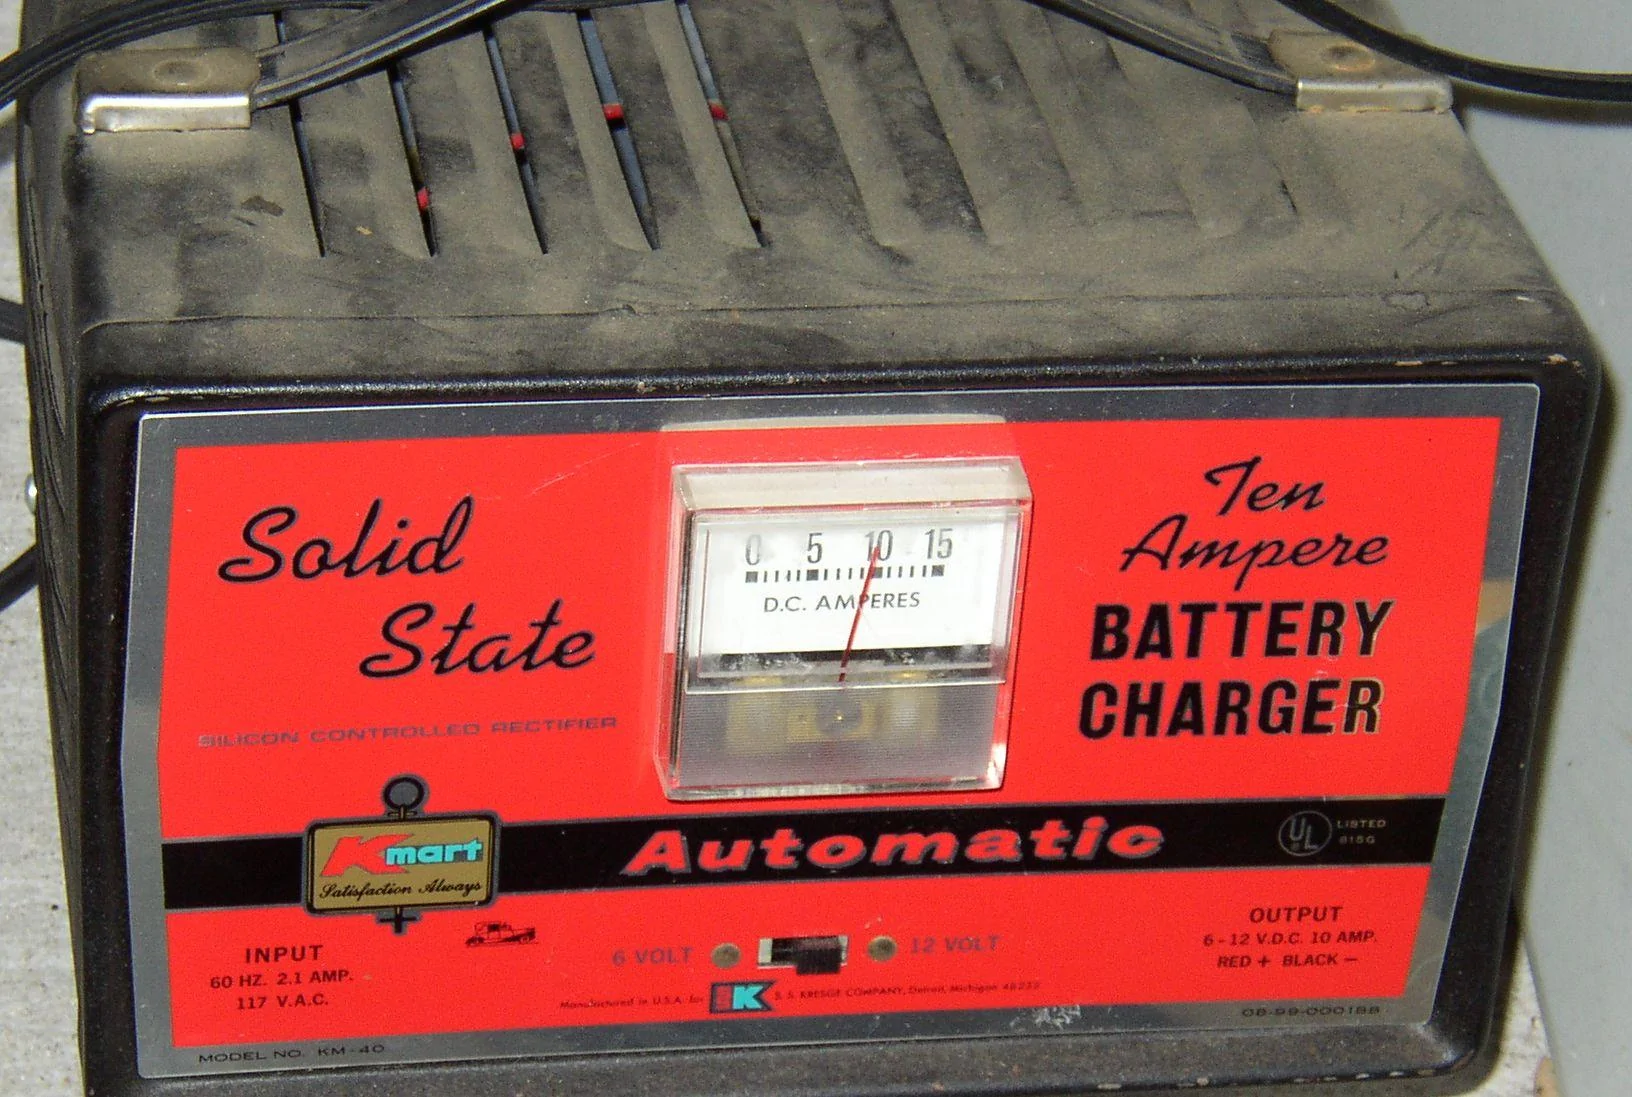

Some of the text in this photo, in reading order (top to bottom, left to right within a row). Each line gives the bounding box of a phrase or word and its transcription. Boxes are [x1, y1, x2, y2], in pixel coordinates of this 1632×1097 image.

[1204, 456, 1326, 517] Ten
[217, 495, 474, 583] Solid
[745, 528, 953, 567] 0 5 10 15
[1119, 514, 1390, 592] Ampere
[764, 591, 922, 613] D.C. AMPERES
[359, 598, 597, 679] State
[1090, 601, 1394, 660] BATTERY
[1078, 677, 1384, 741] CHARGER
[198, 716, 619, 748] SILICON CONTROLLED RECTIFIER
[1336, 819, 1387, 829] LISTED
[621, 816, 1164, 877] Automatic
[318, 877, 483, 900] Satisfaction Always
[1249, 906, 1343, 924] OUTPUT
[910, 935, 1000, 955] 12 VOLT
[1311, 930, 1332, 944] 10
[245, 944, 323, 964] INPUT
[613, 946, 692, 966] 6 VOLT
[1217, 954, 1252, 968] RED
[1282, 953, 1339, 967] BLACK
[210, 975, 233, 989] 60
[276, 971, 303, 986] 2.1
[309, 968, 354, 984] AMP.
[950, 983, 998, 994] Michigan
[237, 992, 330, 1010] 117 V.A.C.
[199, 1052, 267, 1063] MODEL
